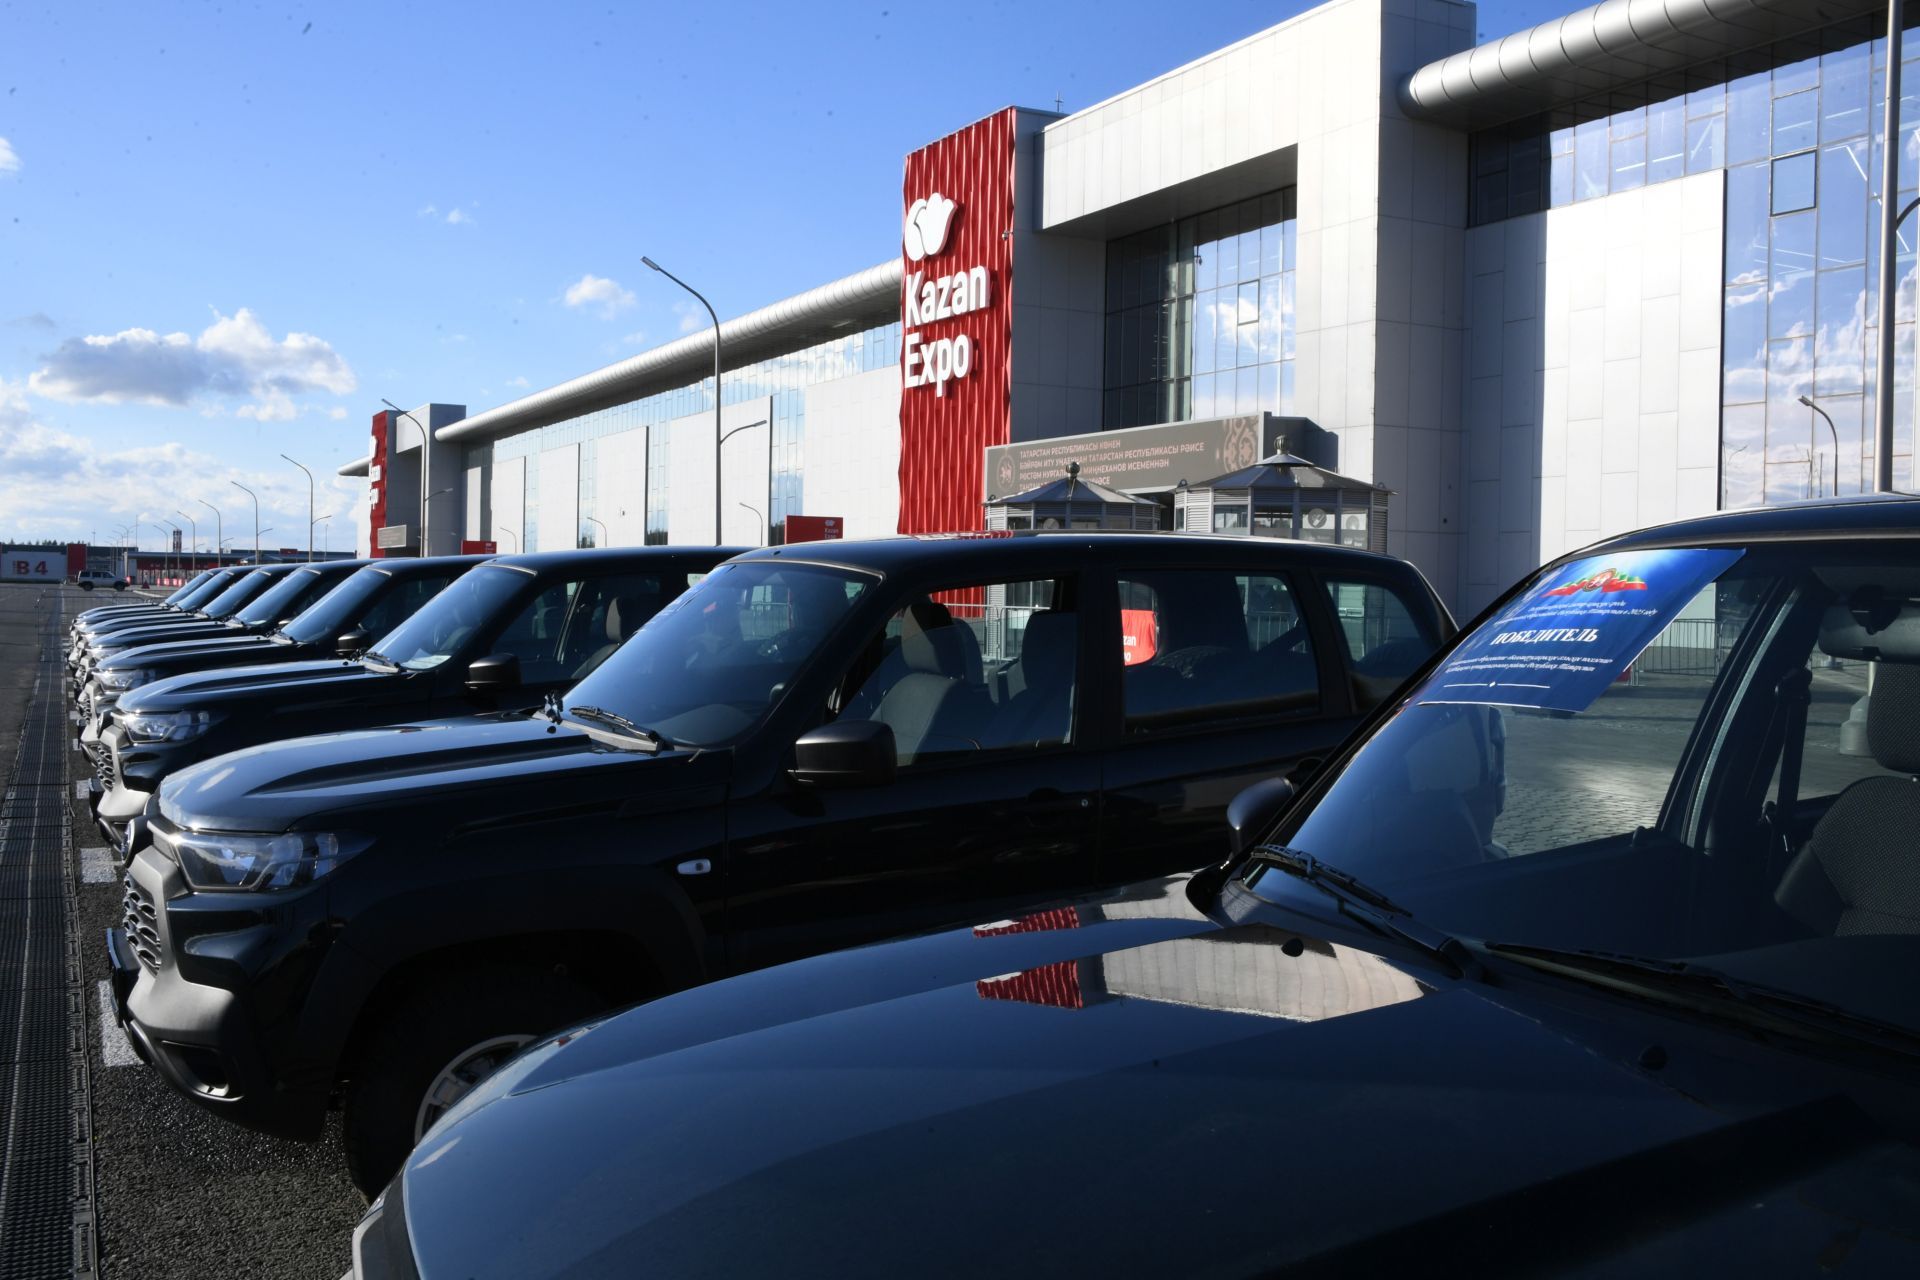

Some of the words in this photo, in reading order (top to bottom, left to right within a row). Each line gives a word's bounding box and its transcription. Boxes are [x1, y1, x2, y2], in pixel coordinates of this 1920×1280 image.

[905, 265, 989, 328] Kazan
[904, 333, 972, 397] Expo
[1020, 448, 1051, 458] ТАТАРСТАН
[1051, 443, 1099, 455] РЕСПУБЛИКАСЫ
[1089, 451, 1123, 462] ТАТАРСТАН
[1124, 446, 1178, 459] РЕСПУБЛИКАСЫ
[1180, 442, 1204, 453] РӘИСЕ
[1128, 458, 1169, 470] ИСЕМЕННӘН
[1490, 628, 1599, 645] ПОБЕДИТЕЛЬ
